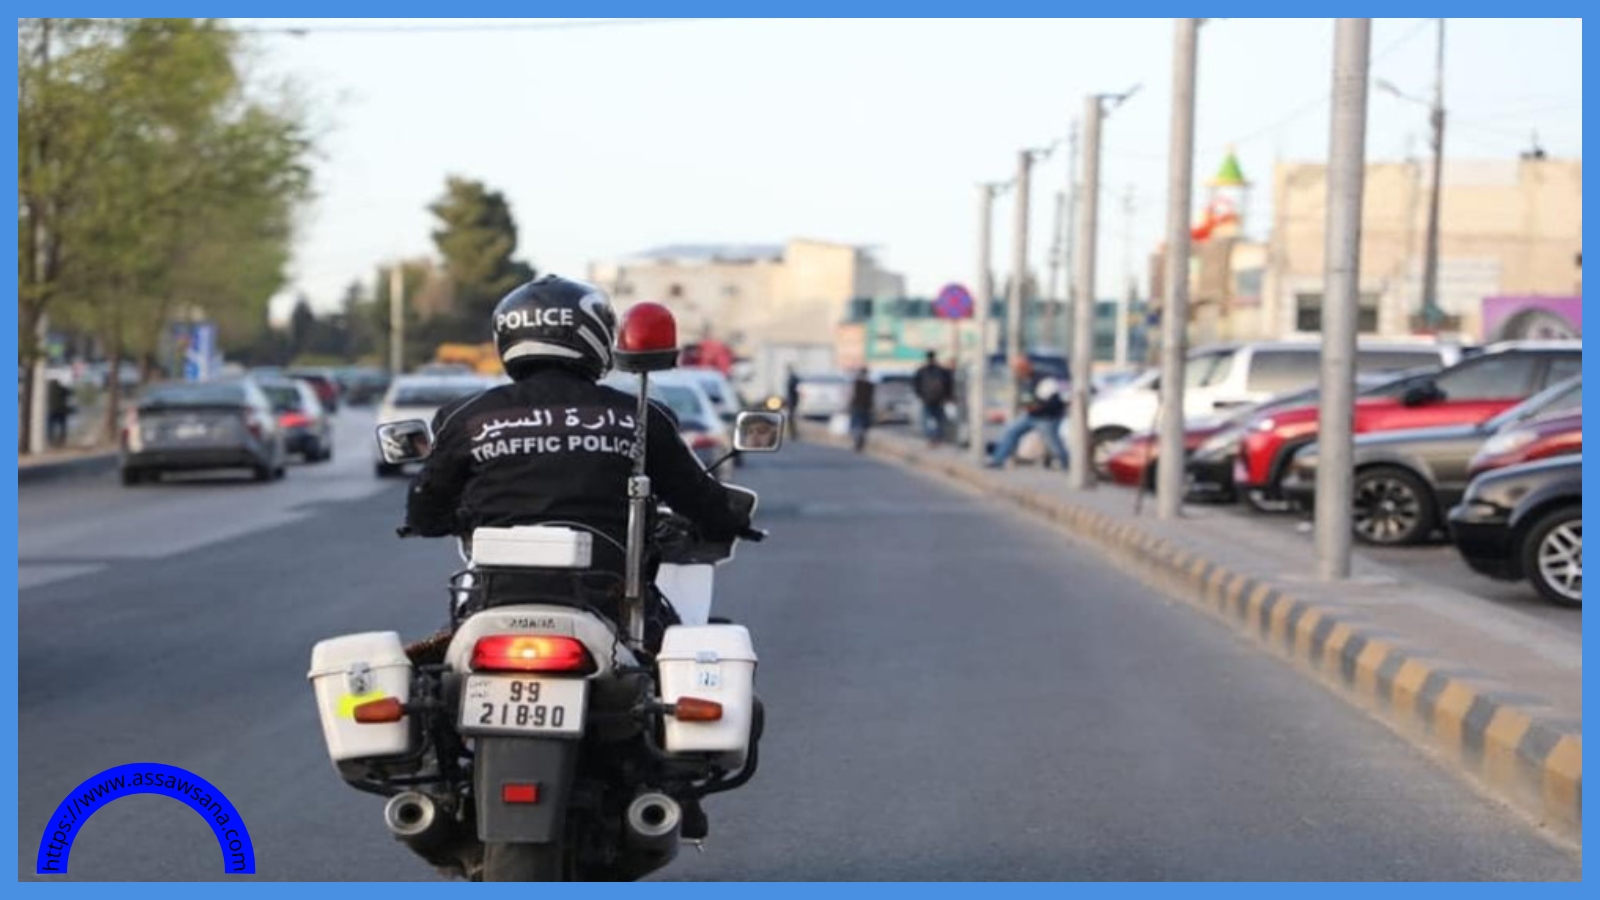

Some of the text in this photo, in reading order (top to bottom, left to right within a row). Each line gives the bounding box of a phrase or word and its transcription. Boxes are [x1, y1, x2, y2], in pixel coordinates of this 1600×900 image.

[497, 308, 574, 331] POLICE
[472, 407, 639, 441] دارة السير
[471, 436, 561, 463] TRAFFIC
